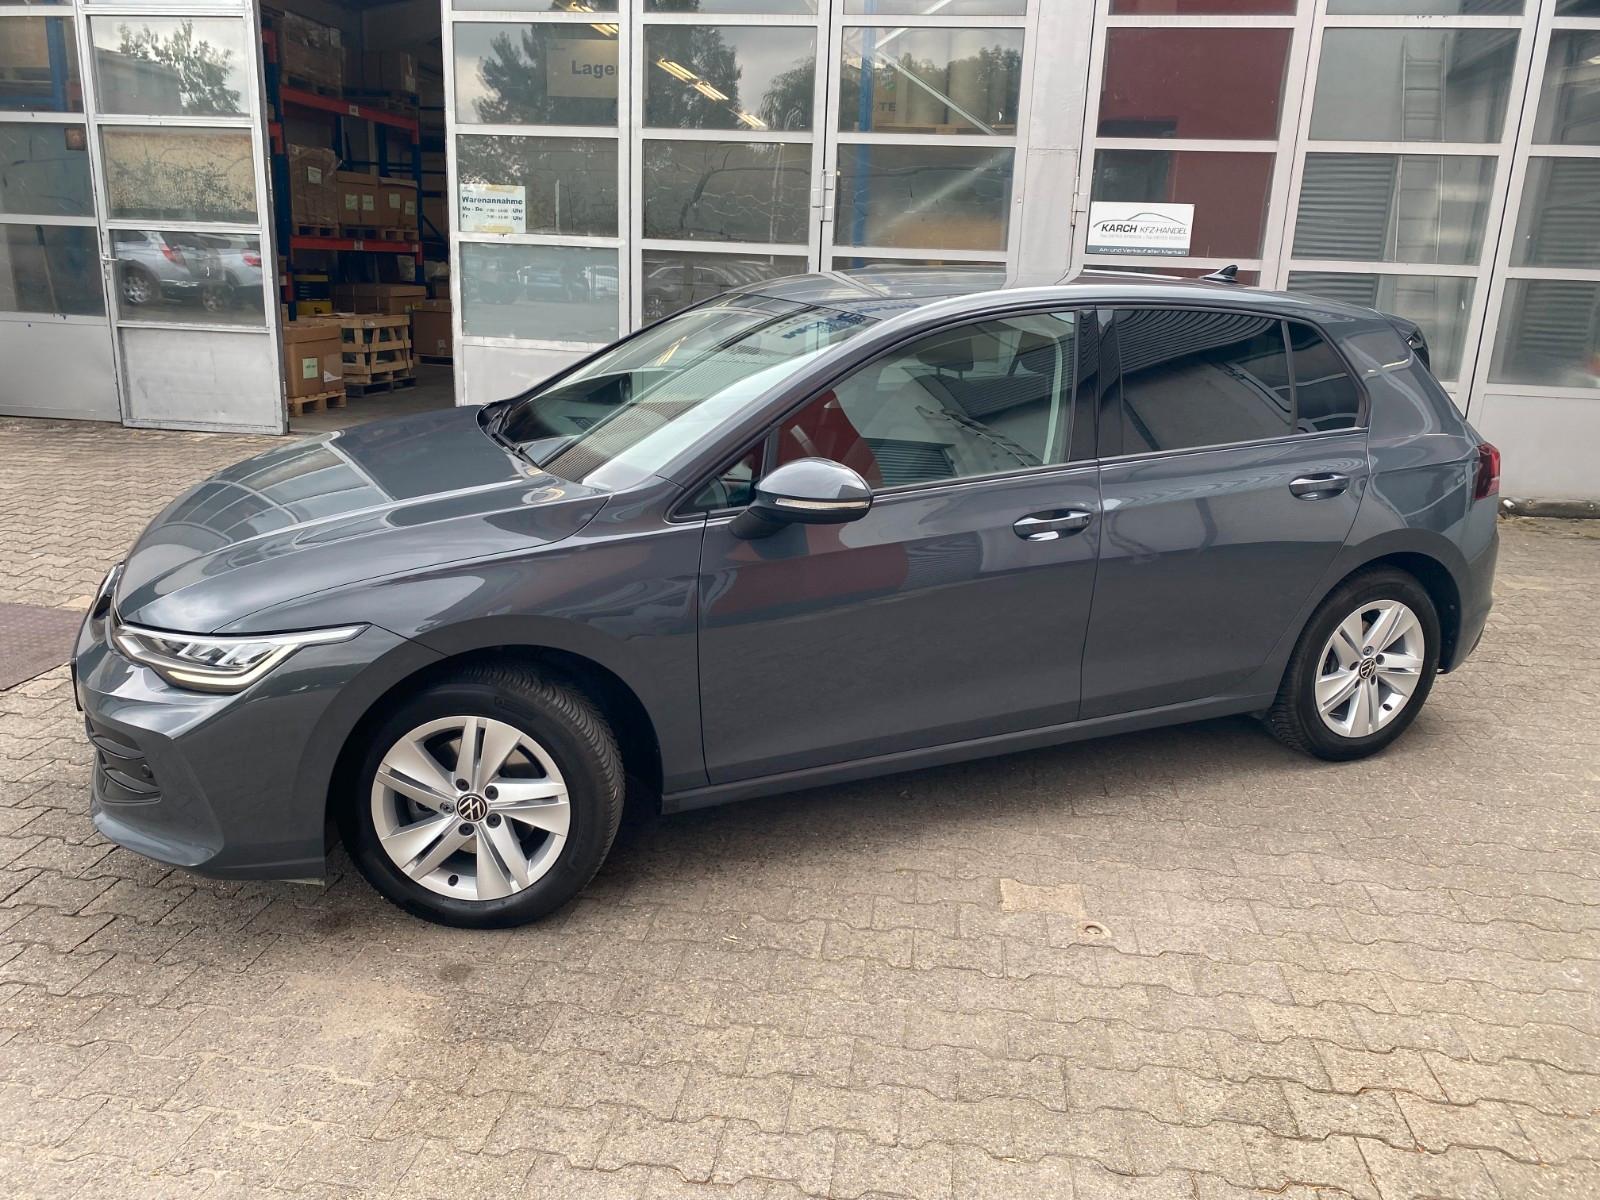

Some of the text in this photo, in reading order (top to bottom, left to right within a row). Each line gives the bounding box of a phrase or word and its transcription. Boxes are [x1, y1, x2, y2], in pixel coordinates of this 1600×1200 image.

[461, 196, 523, 205] Warenannahme
[1101, 223, 1188, 235] KARCH KFZ-HANDEL
